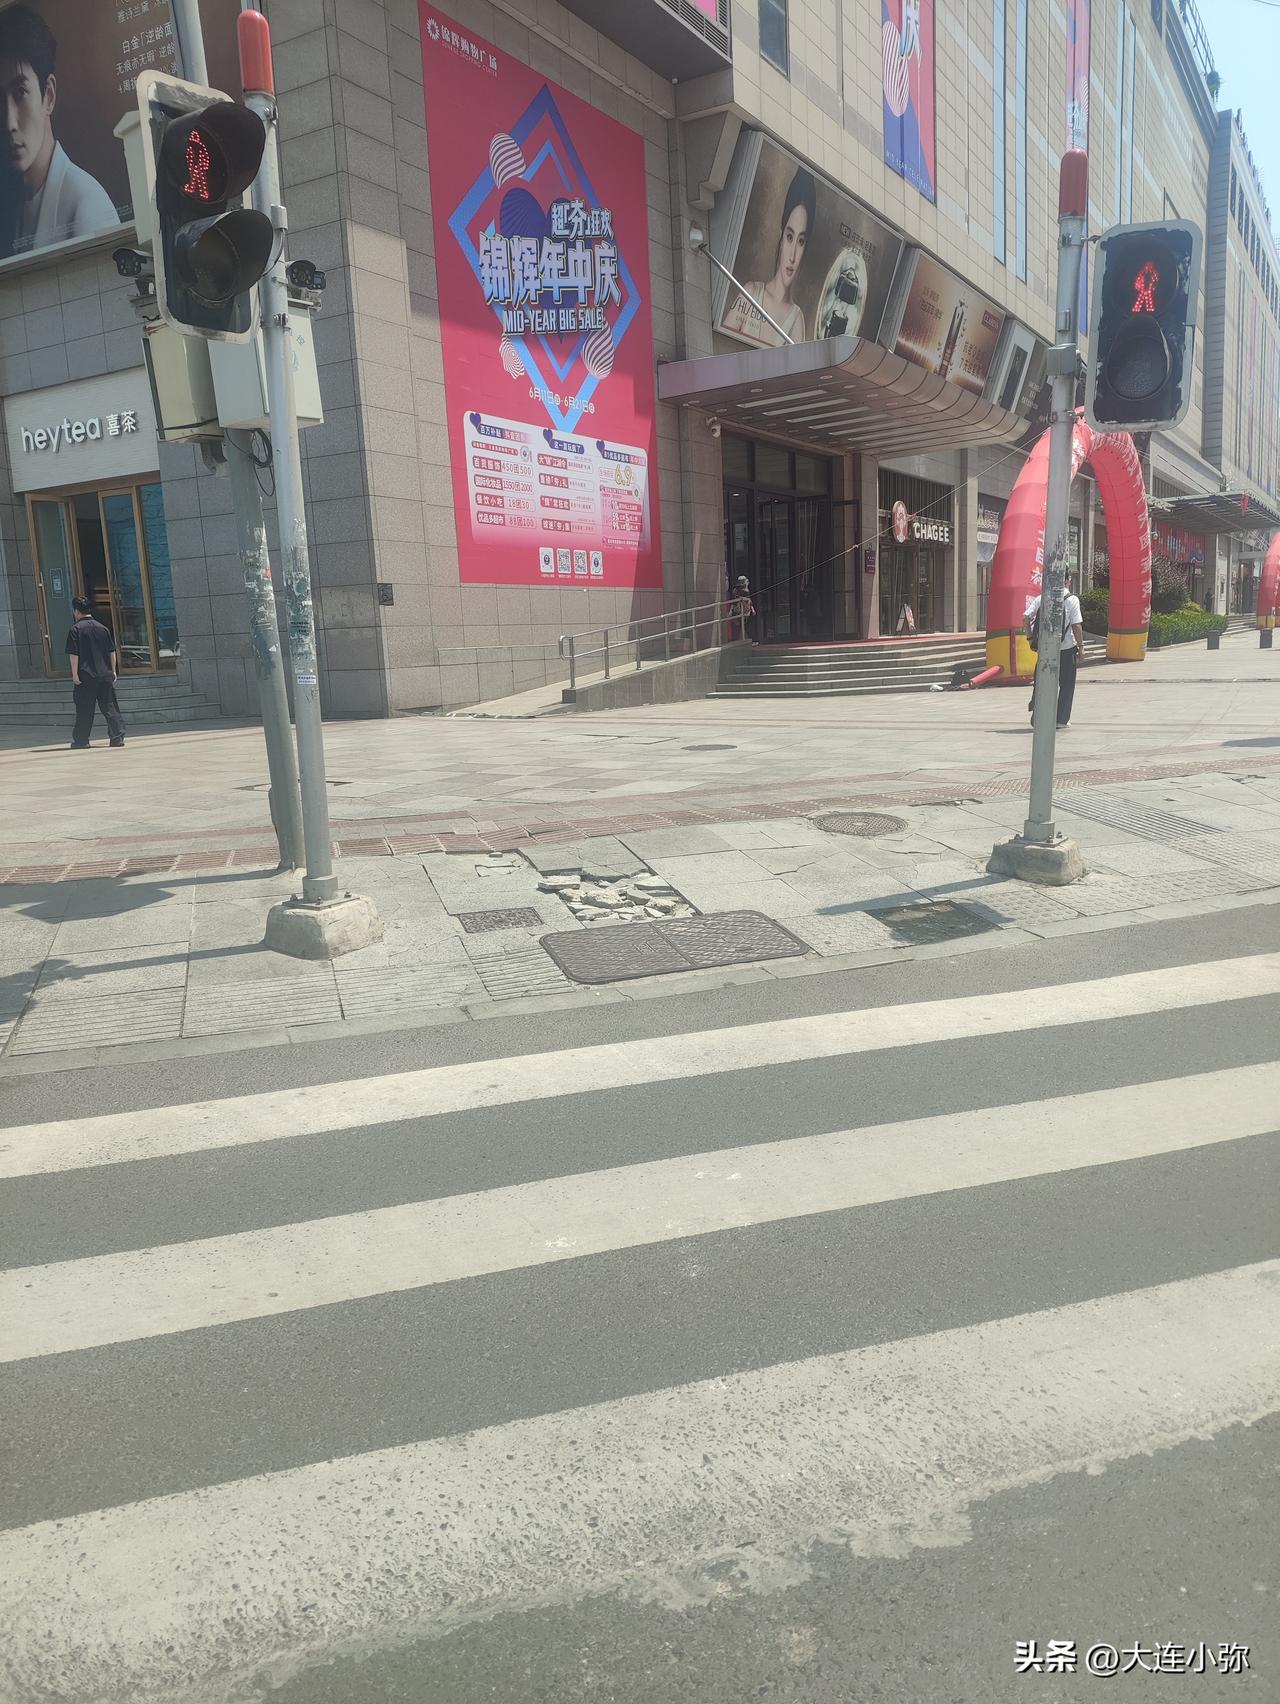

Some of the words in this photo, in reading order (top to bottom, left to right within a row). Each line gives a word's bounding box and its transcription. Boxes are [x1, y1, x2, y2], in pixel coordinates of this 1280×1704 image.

[479, 231, 622, 309] 锦辉年中庆
[503, 309, 557, 335] MID-YEAR
[559, 308, 577, 332] BIG
[578, 307, 604, 331] SALE
[21, 416, 102, 453] heytea
[106, 409, 137, 437] 喜茶
[913, 522, 950, 543] CHAGEE
